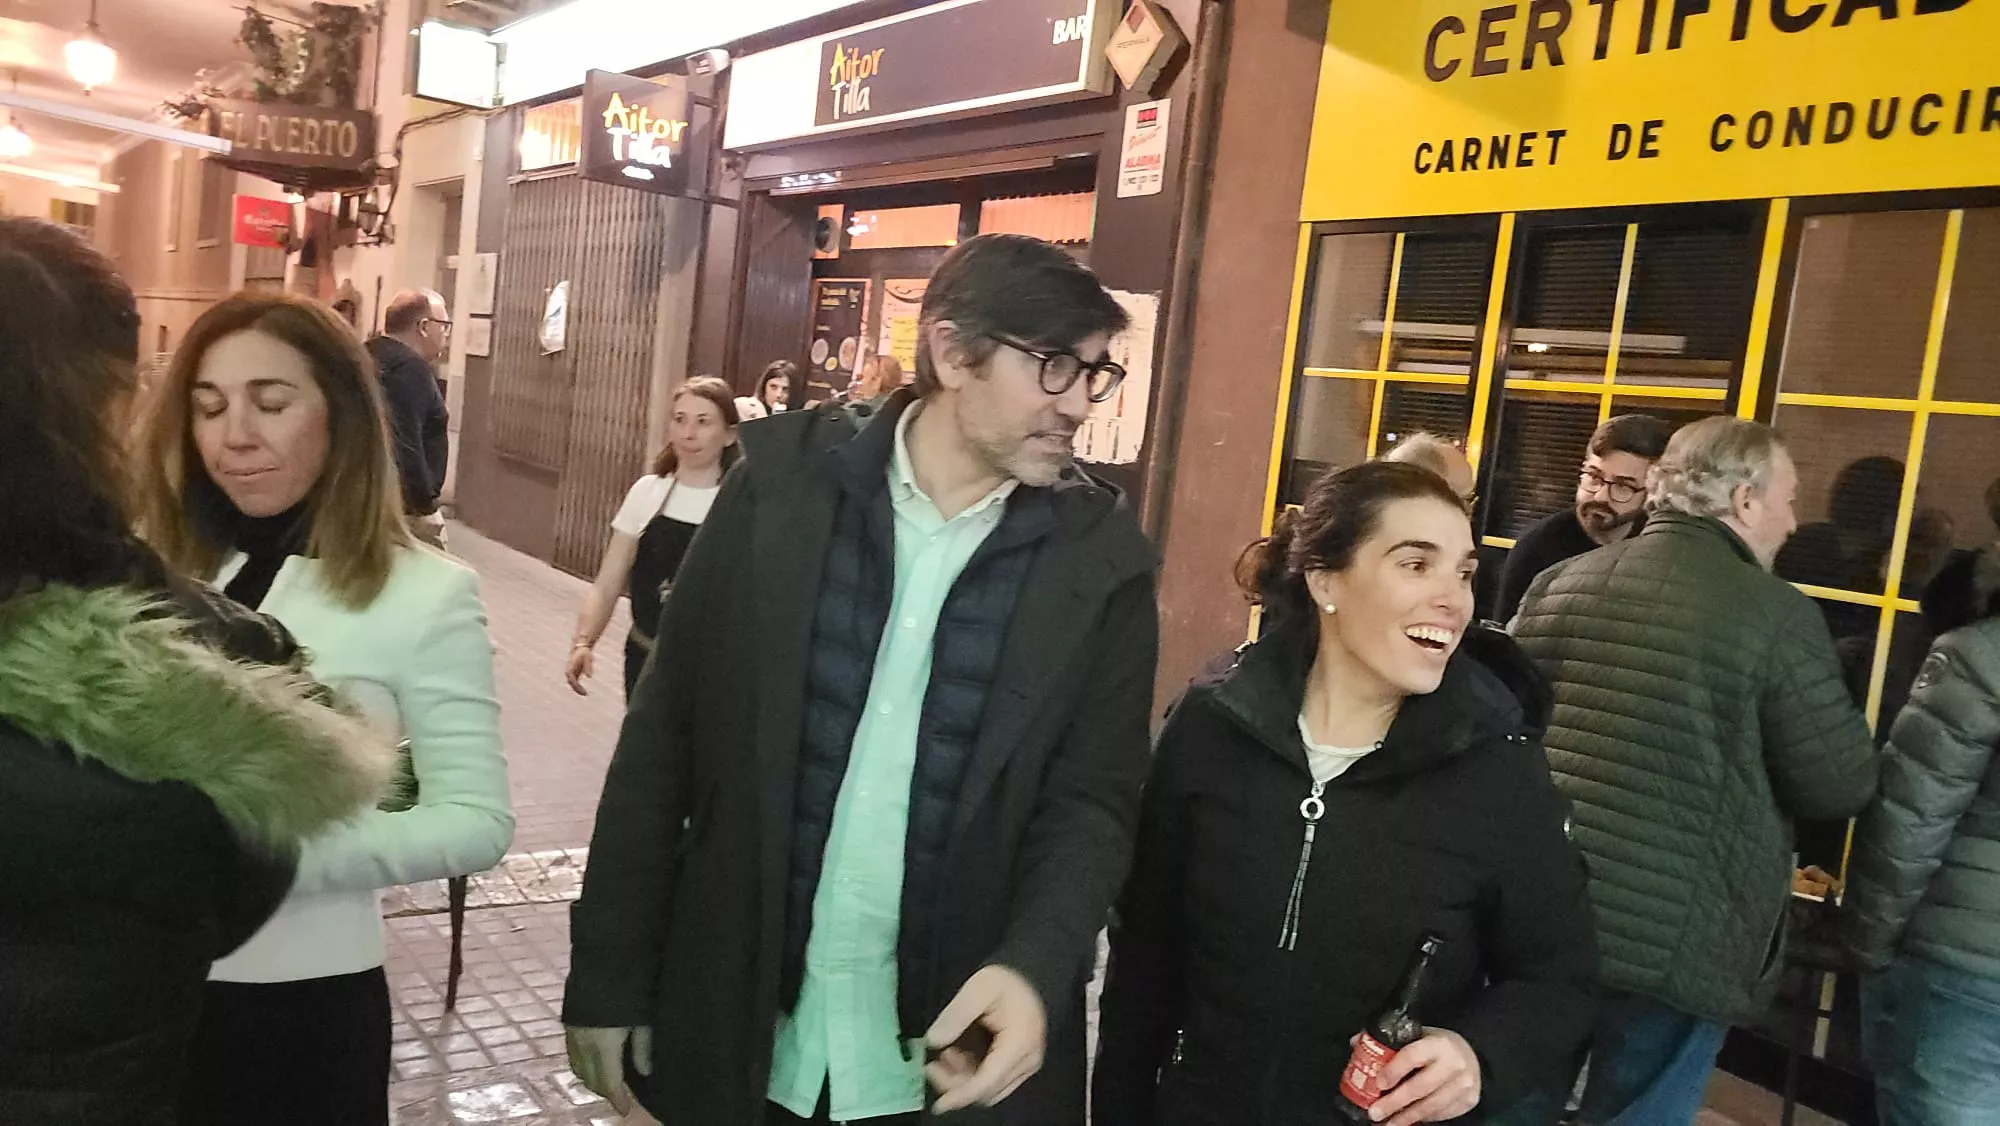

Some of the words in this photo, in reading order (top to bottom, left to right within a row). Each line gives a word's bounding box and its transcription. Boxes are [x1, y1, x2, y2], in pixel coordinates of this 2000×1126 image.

[1052, 14, 1087, 45] BAR
[1424, 0, 1974, 82] CERTIFIC
[830, 42, 885, 86] Aitor
[602, 91, 689, 142] Aitor
[831, 76, 870, 120] Tilla
[220, 111, 249, 149] EL
[254, 114, 358, 158] PUERTO
[606, 127, 672, 168] Tilla
[1414, 129, 1567, 174] CARNET
[1606, 119, 1664, 161] DE
[1709, 86, 2000, 152] CONDUCIR
